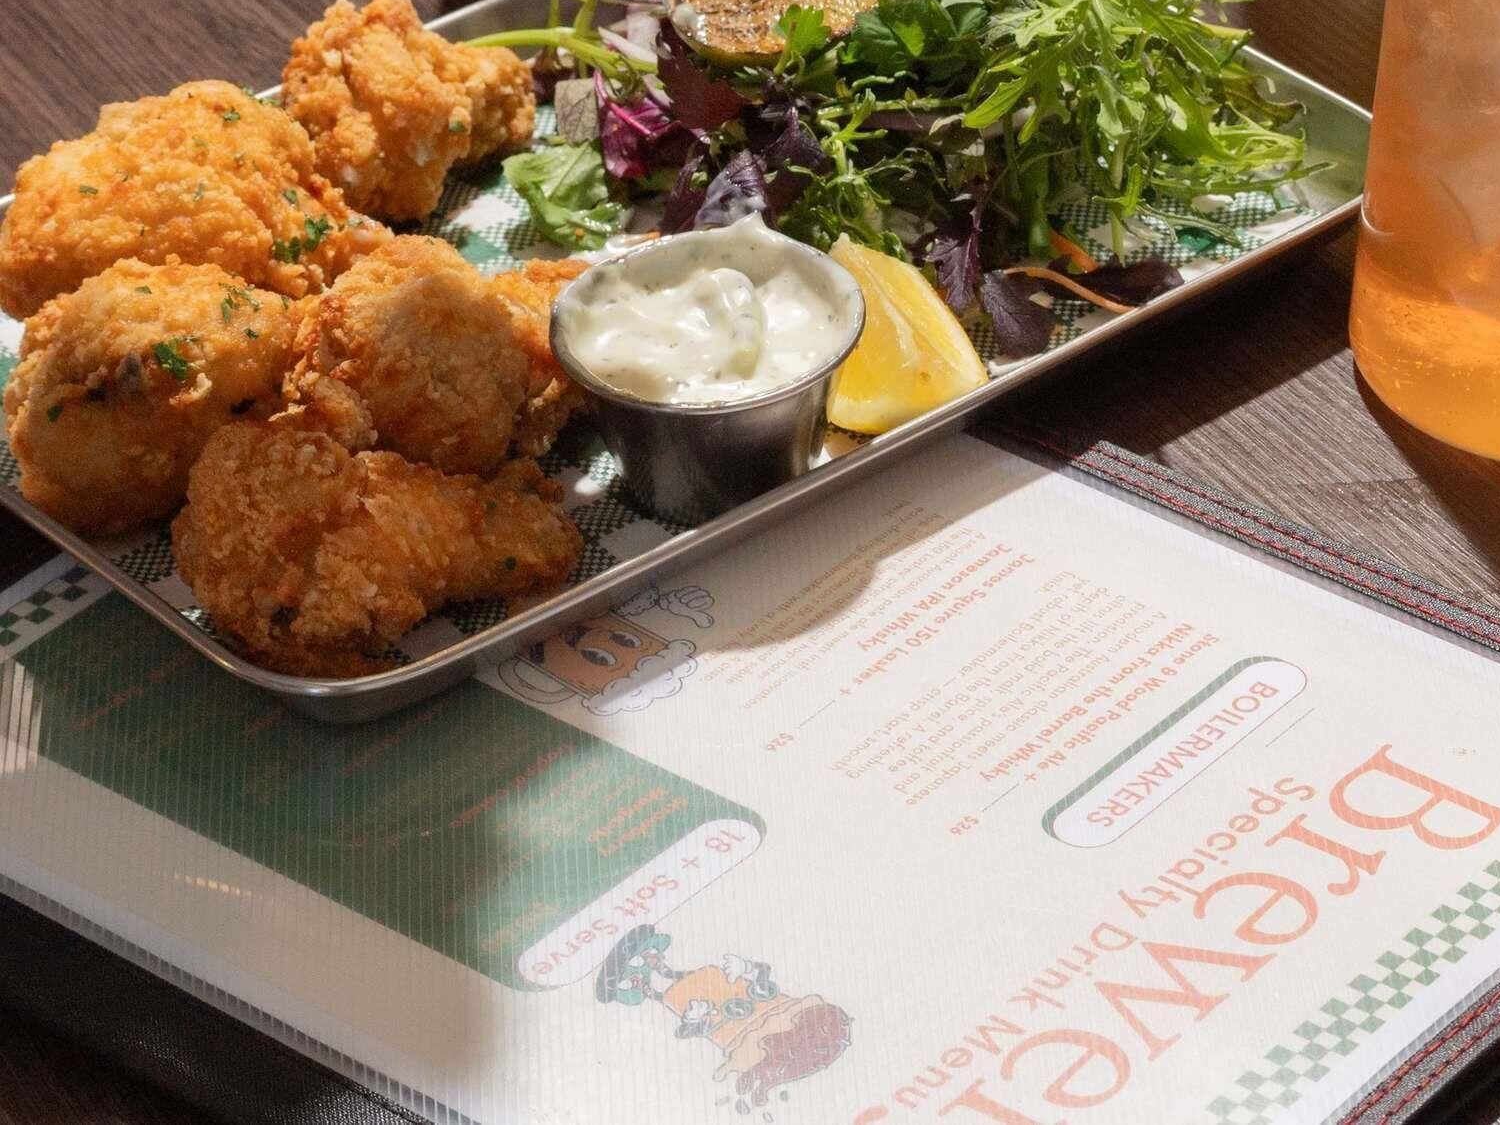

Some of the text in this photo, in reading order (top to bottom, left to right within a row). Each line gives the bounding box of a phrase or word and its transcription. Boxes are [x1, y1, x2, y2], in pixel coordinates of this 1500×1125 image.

[853, 543, 1012, 650] Jameson IPA Whisky
[761, 554, 1036, 752] James Squire 150 Lashes + $26
[1171, 633, 1220, 665] Stone
[978, 623, 1194, 781] Nikka From the Barrel Whisky
[1115, 676, 1164, 710] Wood
[1061, 710, 1122, 749] Pacific
[1034, 750, 1070, 770] Ale
[1084, 681, 1278, 826] BOILERMAKERS
[1022, 771, 1037, 781] +
[702, 829, 746, 853] 18
[947, 815, 979, 836] $26
[613, 874, 681, 919] Soft
[530, 918, 620, 974] Serve
[889, 776, 1318, 1109] Specialty Drink Menu
